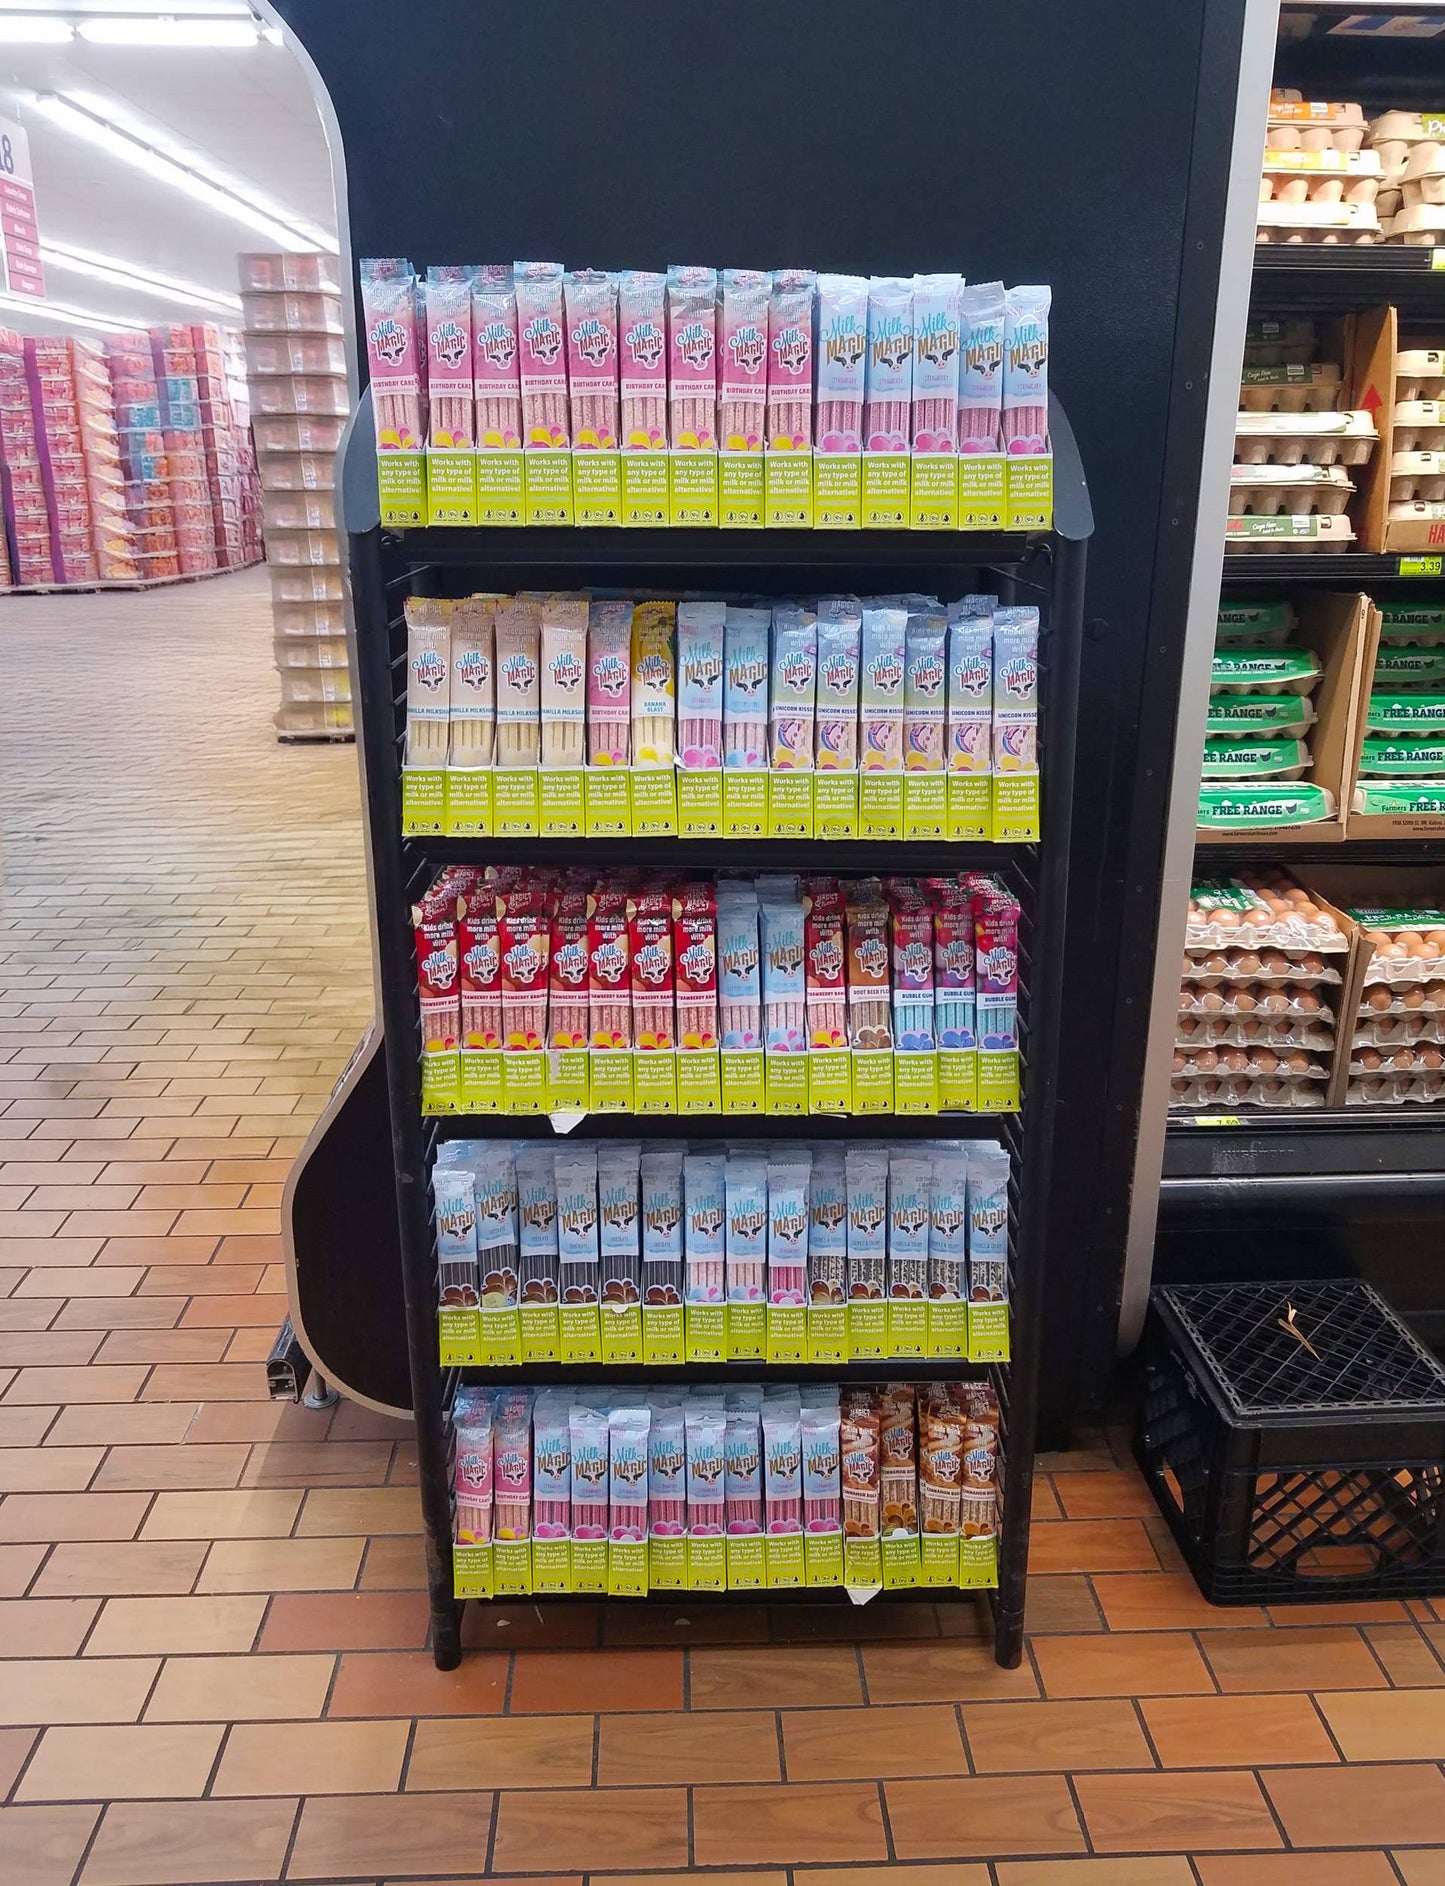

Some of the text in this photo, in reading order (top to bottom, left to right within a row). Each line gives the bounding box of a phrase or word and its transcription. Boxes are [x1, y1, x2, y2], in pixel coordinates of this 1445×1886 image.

[371, 320, 402, 342] Milk
[432, 322, 462, 343] Milk
[479, 324, 512, 344] Milk
[573, 321, 606, 341] Milk
[821, 315, 866, 341] Milk
[377, 333, 406, 357] MAGIC
[580, 333, 609, 357] MAGIC
[730, 328, 762, 347] Milk
[438, 336, 465, 358] MAGIC
[486, 338, 515, 359] MAGIC
[736, 342, 764, 363] MAGIC
[1421, 562, 1440, 570] 3.39
[1395, 615, 1428, 623] RANGE
[412, 652, 443, 669] Milk
[594, 657, 624, 674] Milk
[637, 656, 667, 672] Milk
[780, 653, 809, 670] Milk
[1001, 659, 1033, 677] Milk
[418, 665, 445, 684] MAGIC
[600, 669, 626, 688] MAGIC
[643, 668, 670, 685] MAGIC
[785, 664, 811, 684] MAGIC
[1007, 670, 1035, 690] MAGIC
[1224, 709, 1262, 718] RANGE
[1383, 709, 1409, 717] FREE
[1413, 709, 1445, 717] RANG
[1219, 754, 1256, 762] RANGE
[1378, 752, 1404, 761] FREE
[1407, 752, 1442, 760] RANGE
[1213, 806, 1241, 815] FREE
[1243, 806, 1282, 814] RANGE
[1410, 803, 1436, 811] FREE
[465, 946, 495, 962] Milk
[856, 940, 883, 957] Milk
[901, 944, 928, 959] Milk
[984, 948, 1012, 963] Milk
[472, 957, 497, 977] MAGIC
[862, 950, 886, 971] MAGIC
[906, 953, 931, 975] MAGIC
[989, 959, 1015, 979] MAGIC
[435, 1197, 472, 1218] Milk
[559, 1194, 594, 1215] Milk
[891, 1194, 925, 1213] Milk
[440, 1211, 474, 1236] MAGIC
[563, 1209, 596, 1235] MAGIC
[893, 1209, 927, 1231] MAGIC
[884, 1427, 910, 1441] Milk
[889, 1436, 913, 1453] MAGIC
[498, 1454, 522, 1465] Milk
[845, 1453, 870, 1464] Milk
[966, 1451, 991, 1462] Milk
[503, 1463, 525, 1478] MAGIC
[850, 1460, 873, 1474] MAGIC
[970, 1459, 994, 1474] MAGIC
